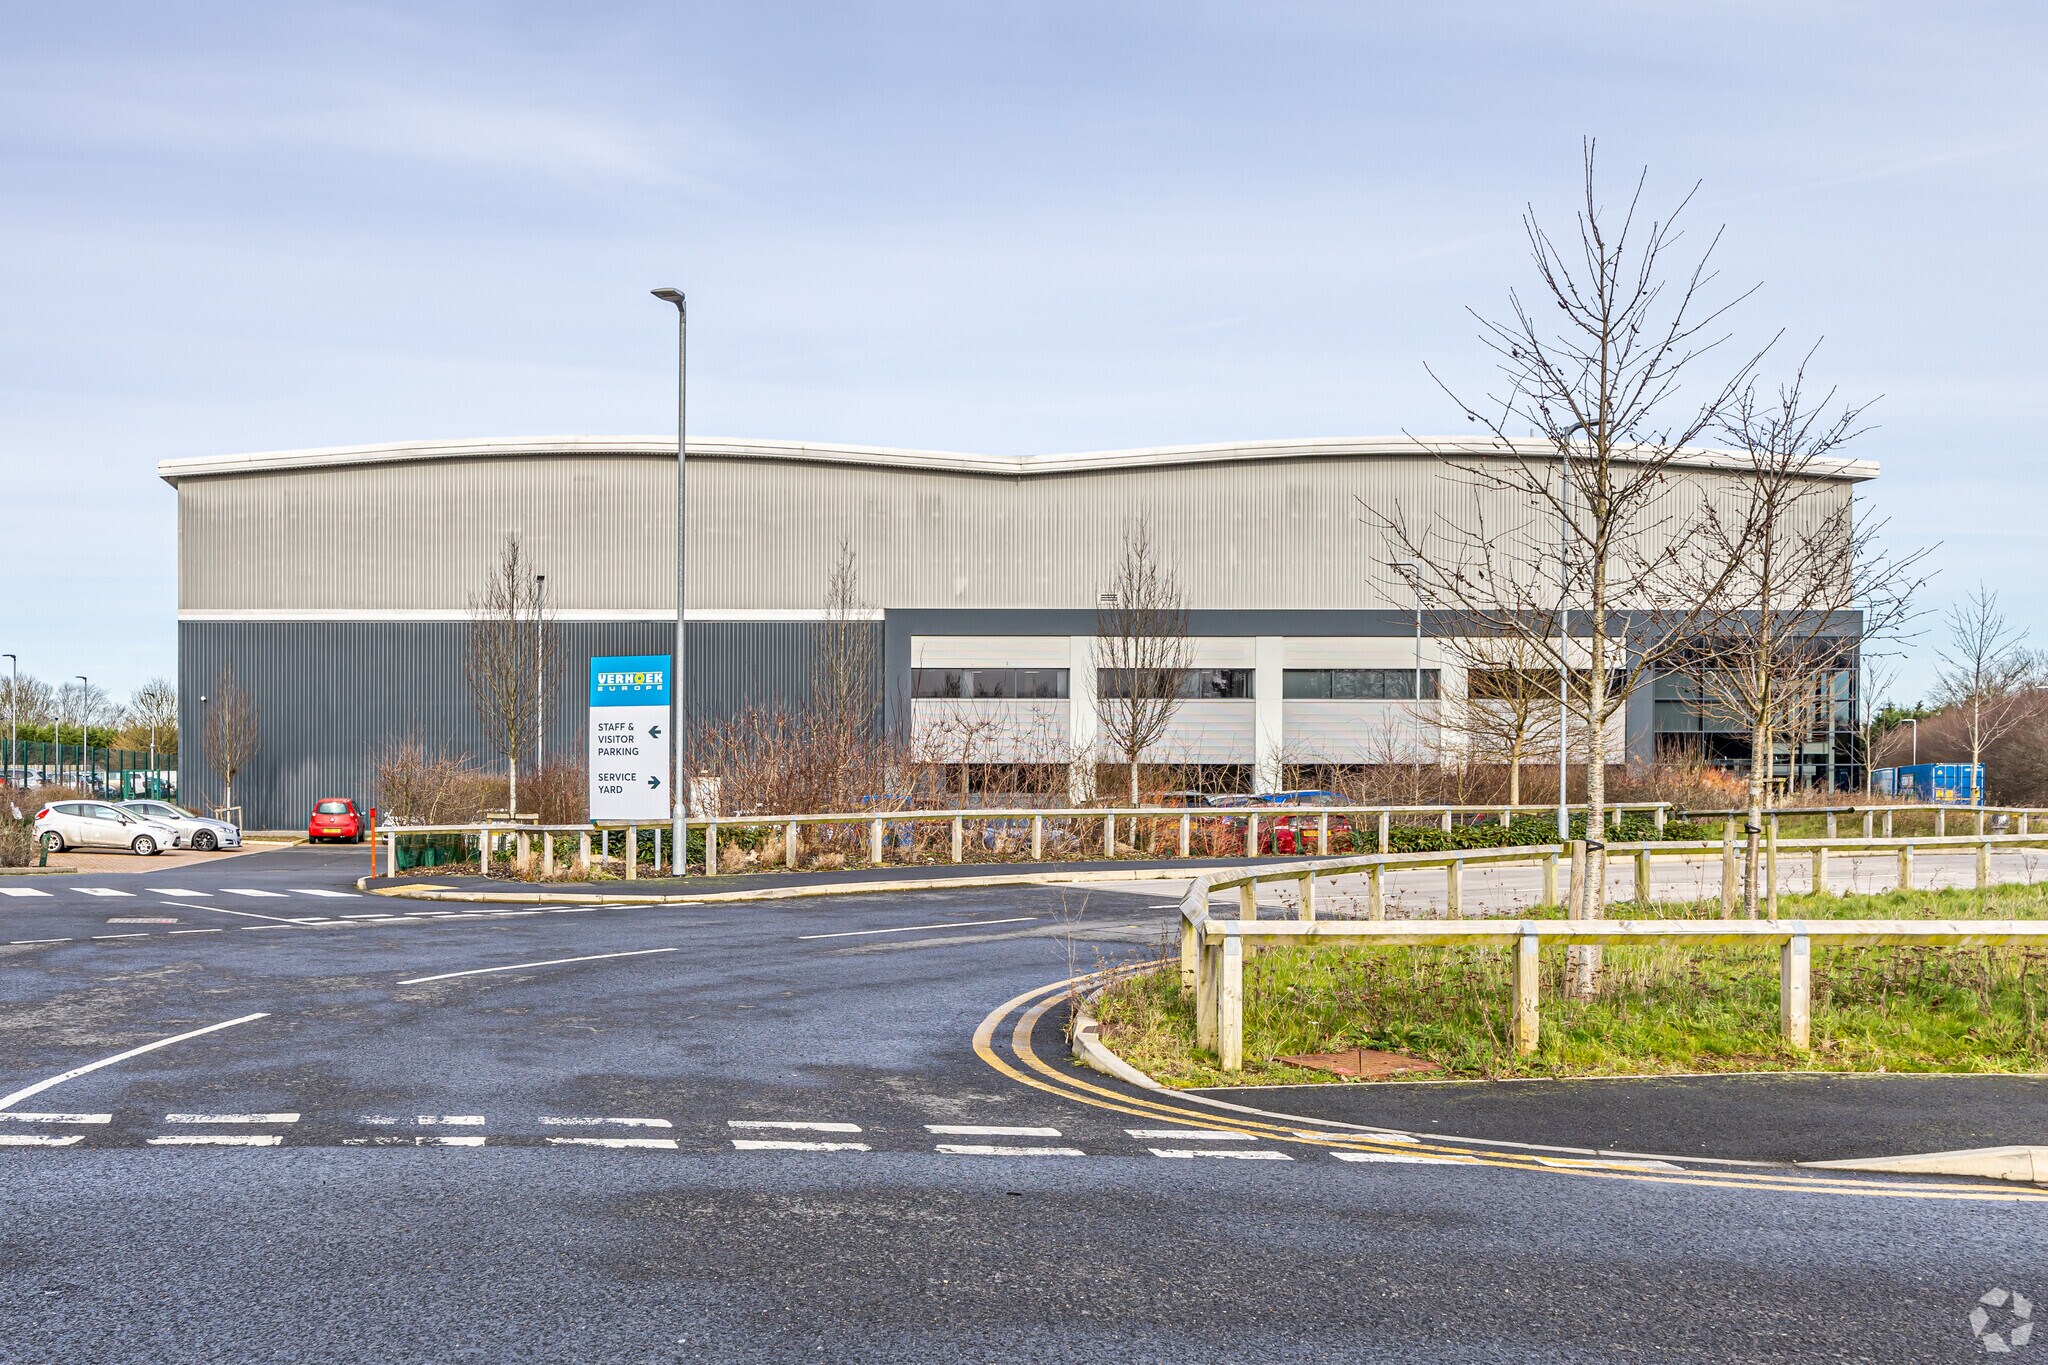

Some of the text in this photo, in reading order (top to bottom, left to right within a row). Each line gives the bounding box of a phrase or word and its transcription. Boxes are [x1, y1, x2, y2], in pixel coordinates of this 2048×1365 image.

[598, 673, 663, 685] VERHOEK
[598, 723, 634, 731] STAFF &
[598, 735, 635, 744] VISITOR
[598, 747, 639, 756] PARKING
[598, 773, 637, 782] SERVICE
[598, 785, 623, 794] YARD
